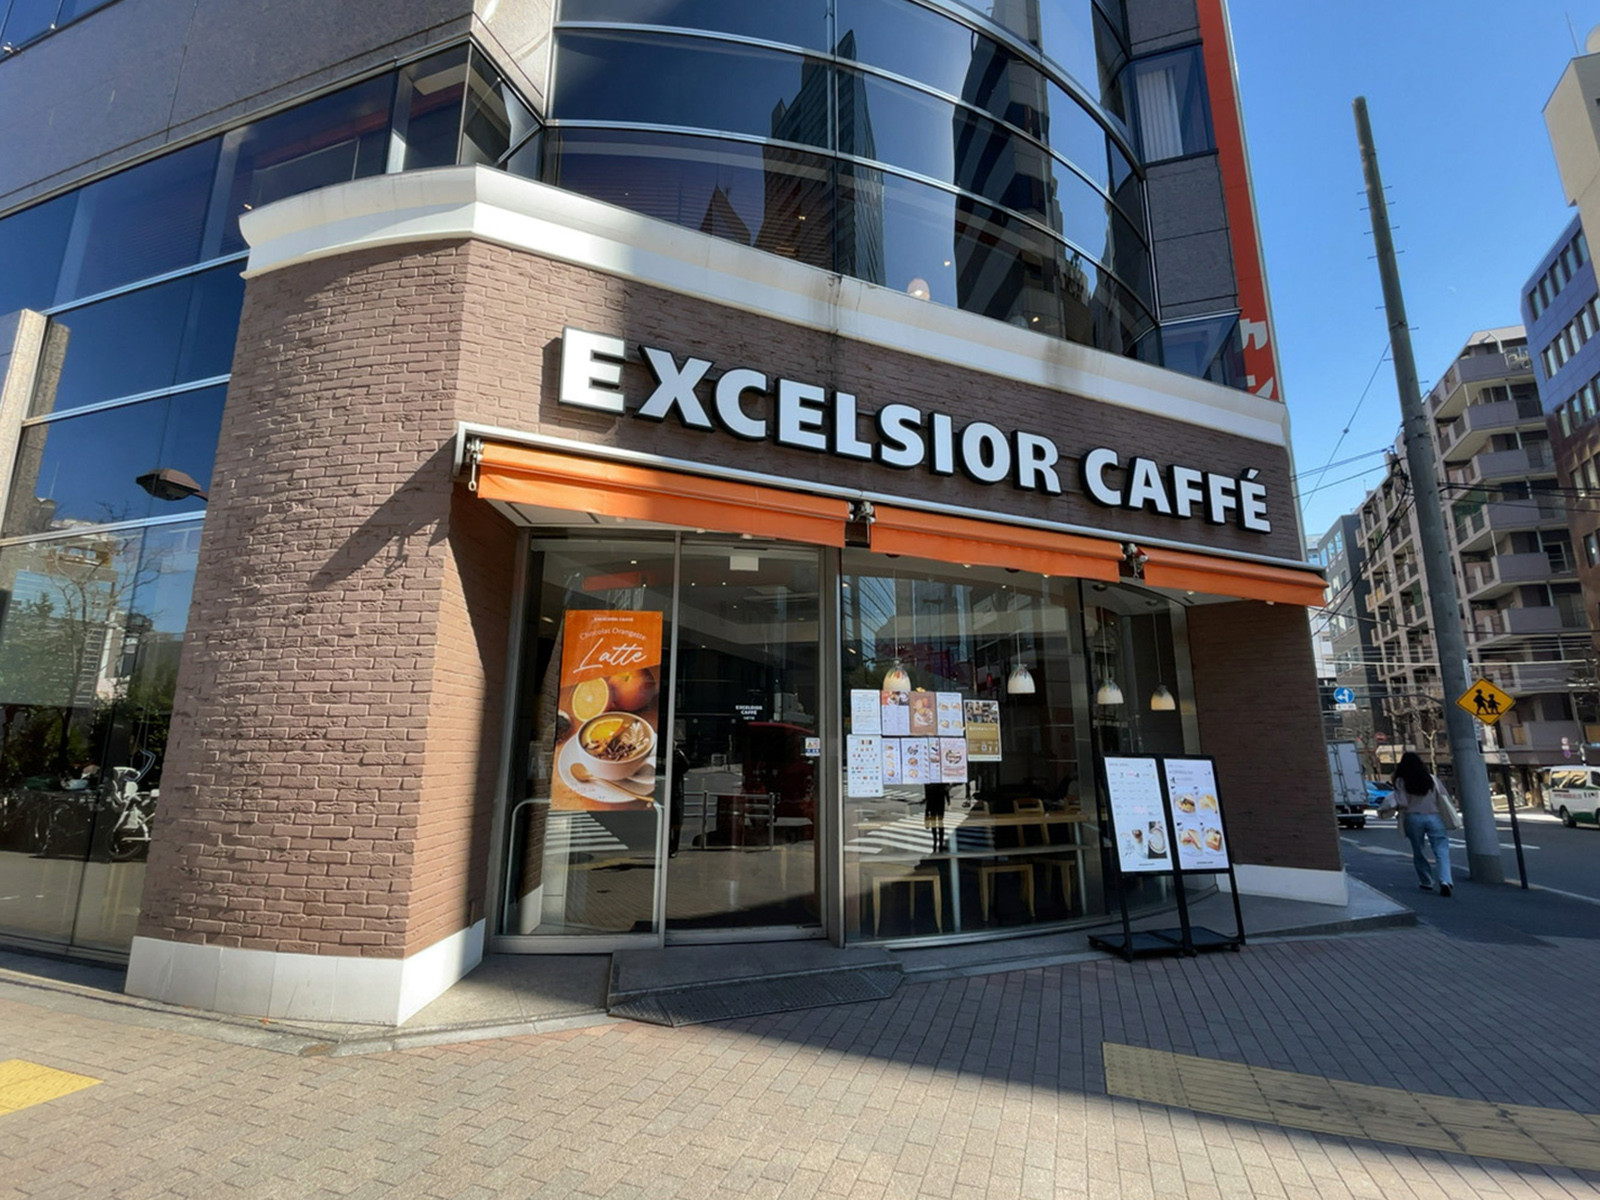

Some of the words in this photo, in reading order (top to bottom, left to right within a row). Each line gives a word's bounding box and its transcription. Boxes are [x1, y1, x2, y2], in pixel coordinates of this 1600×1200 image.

[558, 326, 1062, 496] EXCELSIOR
[1081, 447, 1272, 533] CAFFÉ
[580, 627, 610, 640] Chocolat
[612, 627, 646, 640] Orangette
[573, 637, 647, 674] Latte
